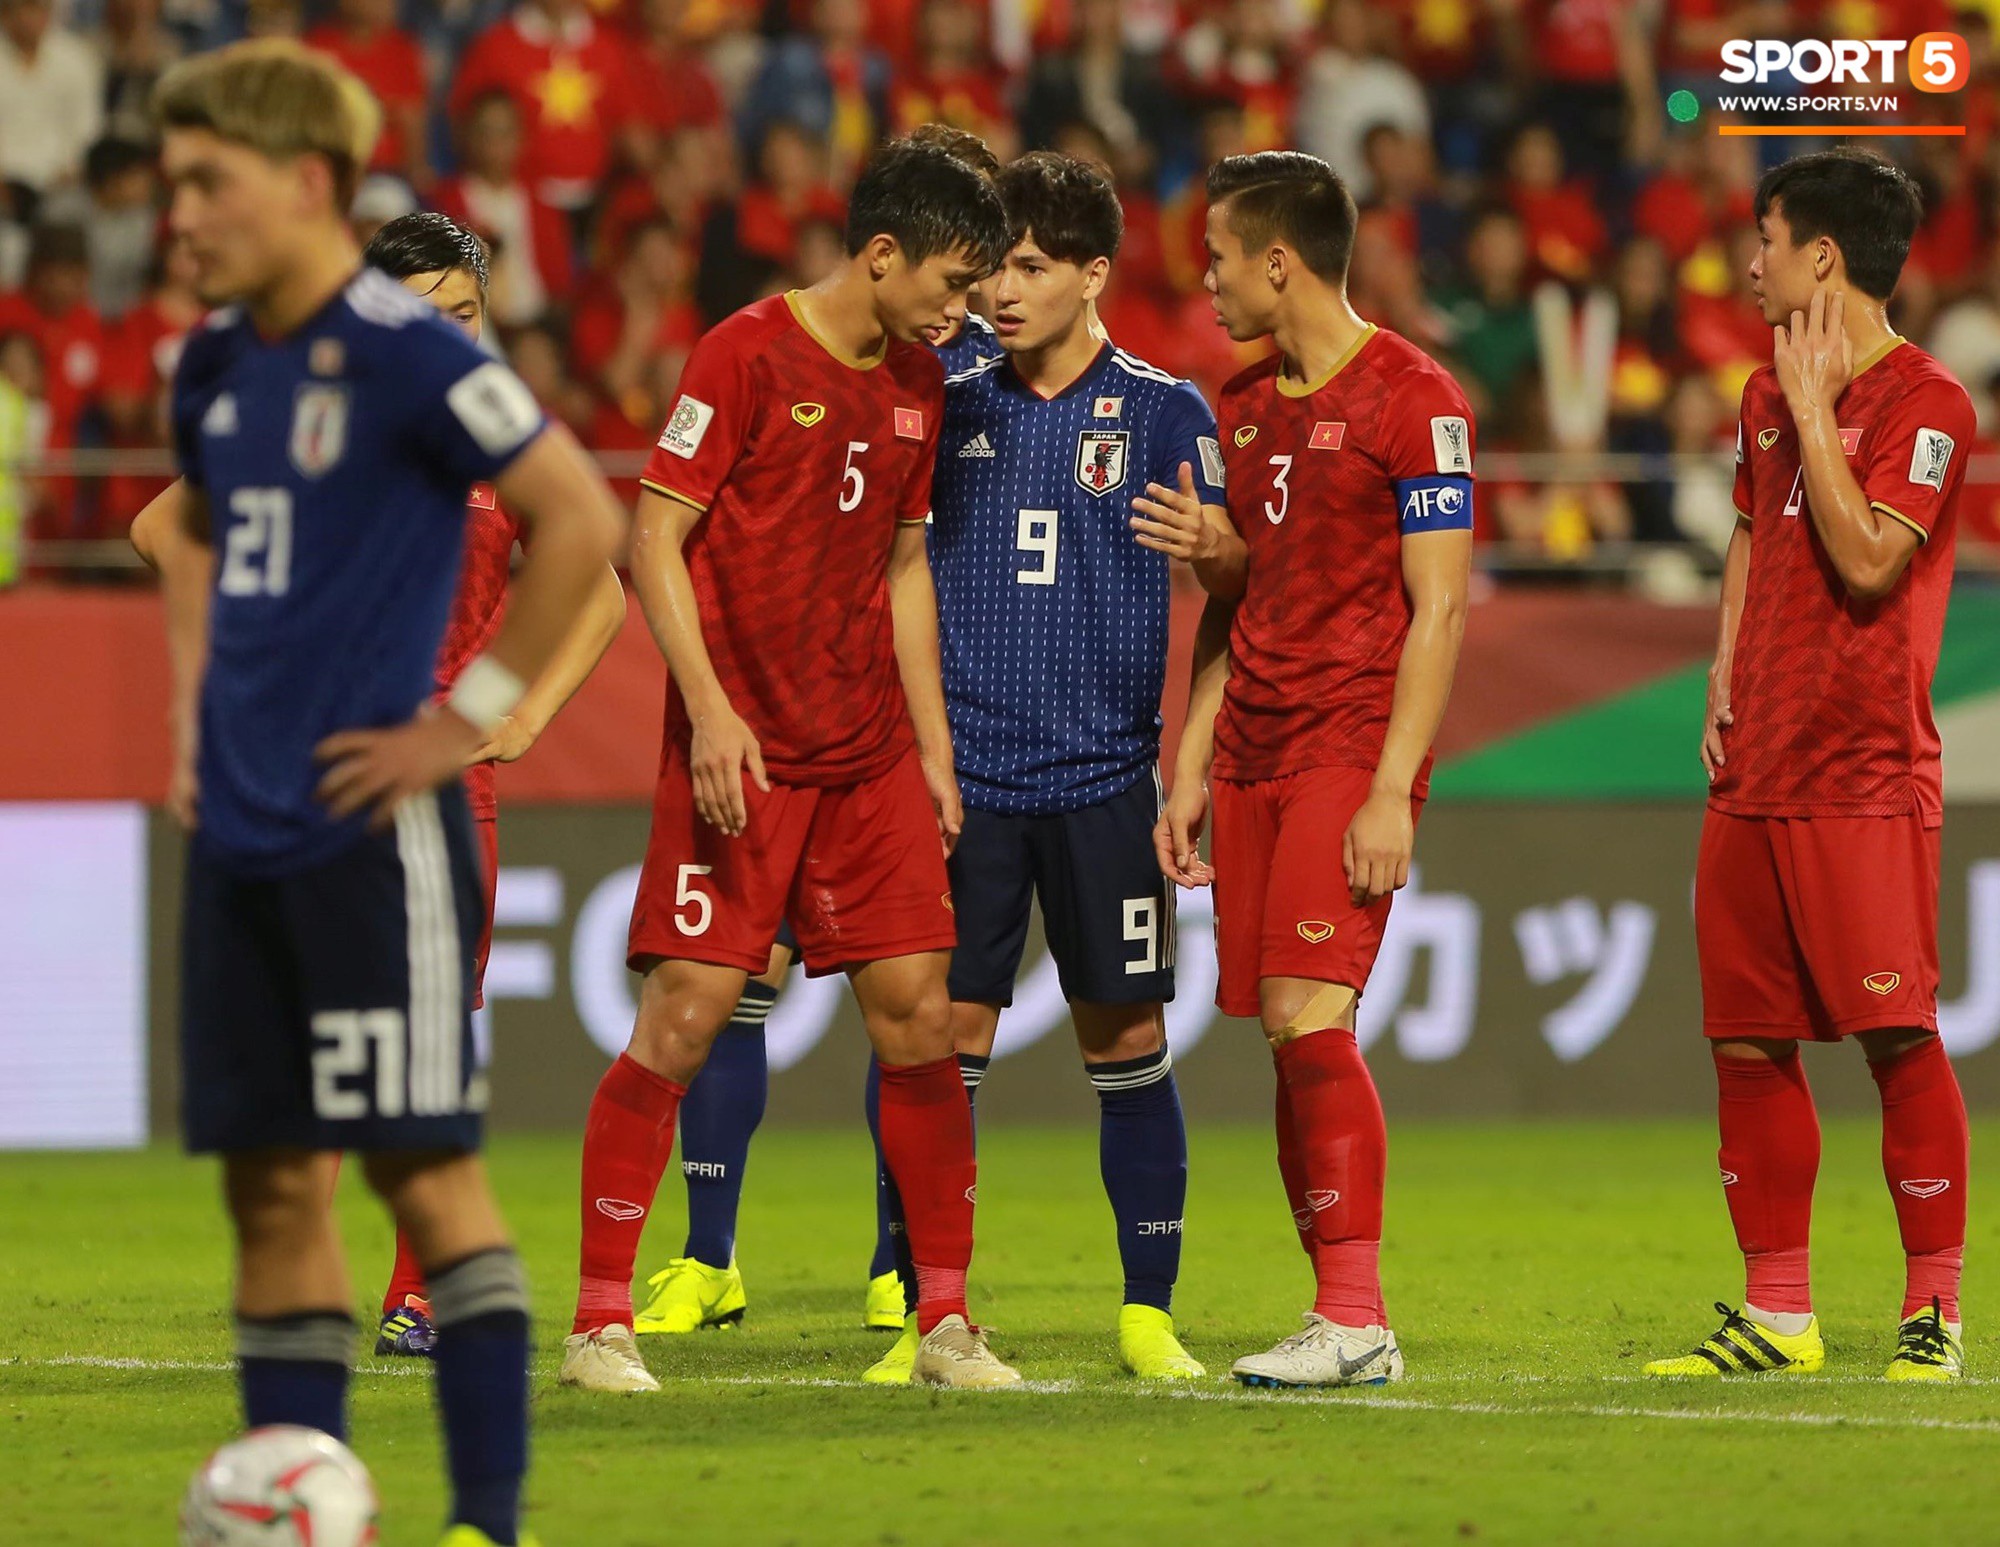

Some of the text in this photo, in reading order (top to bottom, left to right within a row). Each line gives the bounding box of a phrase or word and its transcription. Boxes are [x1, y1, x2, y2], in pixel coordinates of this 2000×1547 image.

[838, 441, 869, 512] 5
[958, 447, 996, 458] adidas
[1264, 455, 1293, 525] 3
[1402, 486, 1465, 520] AFC
[218, 486, 295, 598] 21
[1016, 509, 1059, 586] 9
[674, 864, 713, 937] 5
[1122, 897, 1157, 975] 9
[309, 1007, 406, 1120] 21
[682, 1161, 725, 1178] APAN
[1137, 1217, 1184, 1235] JAPA
